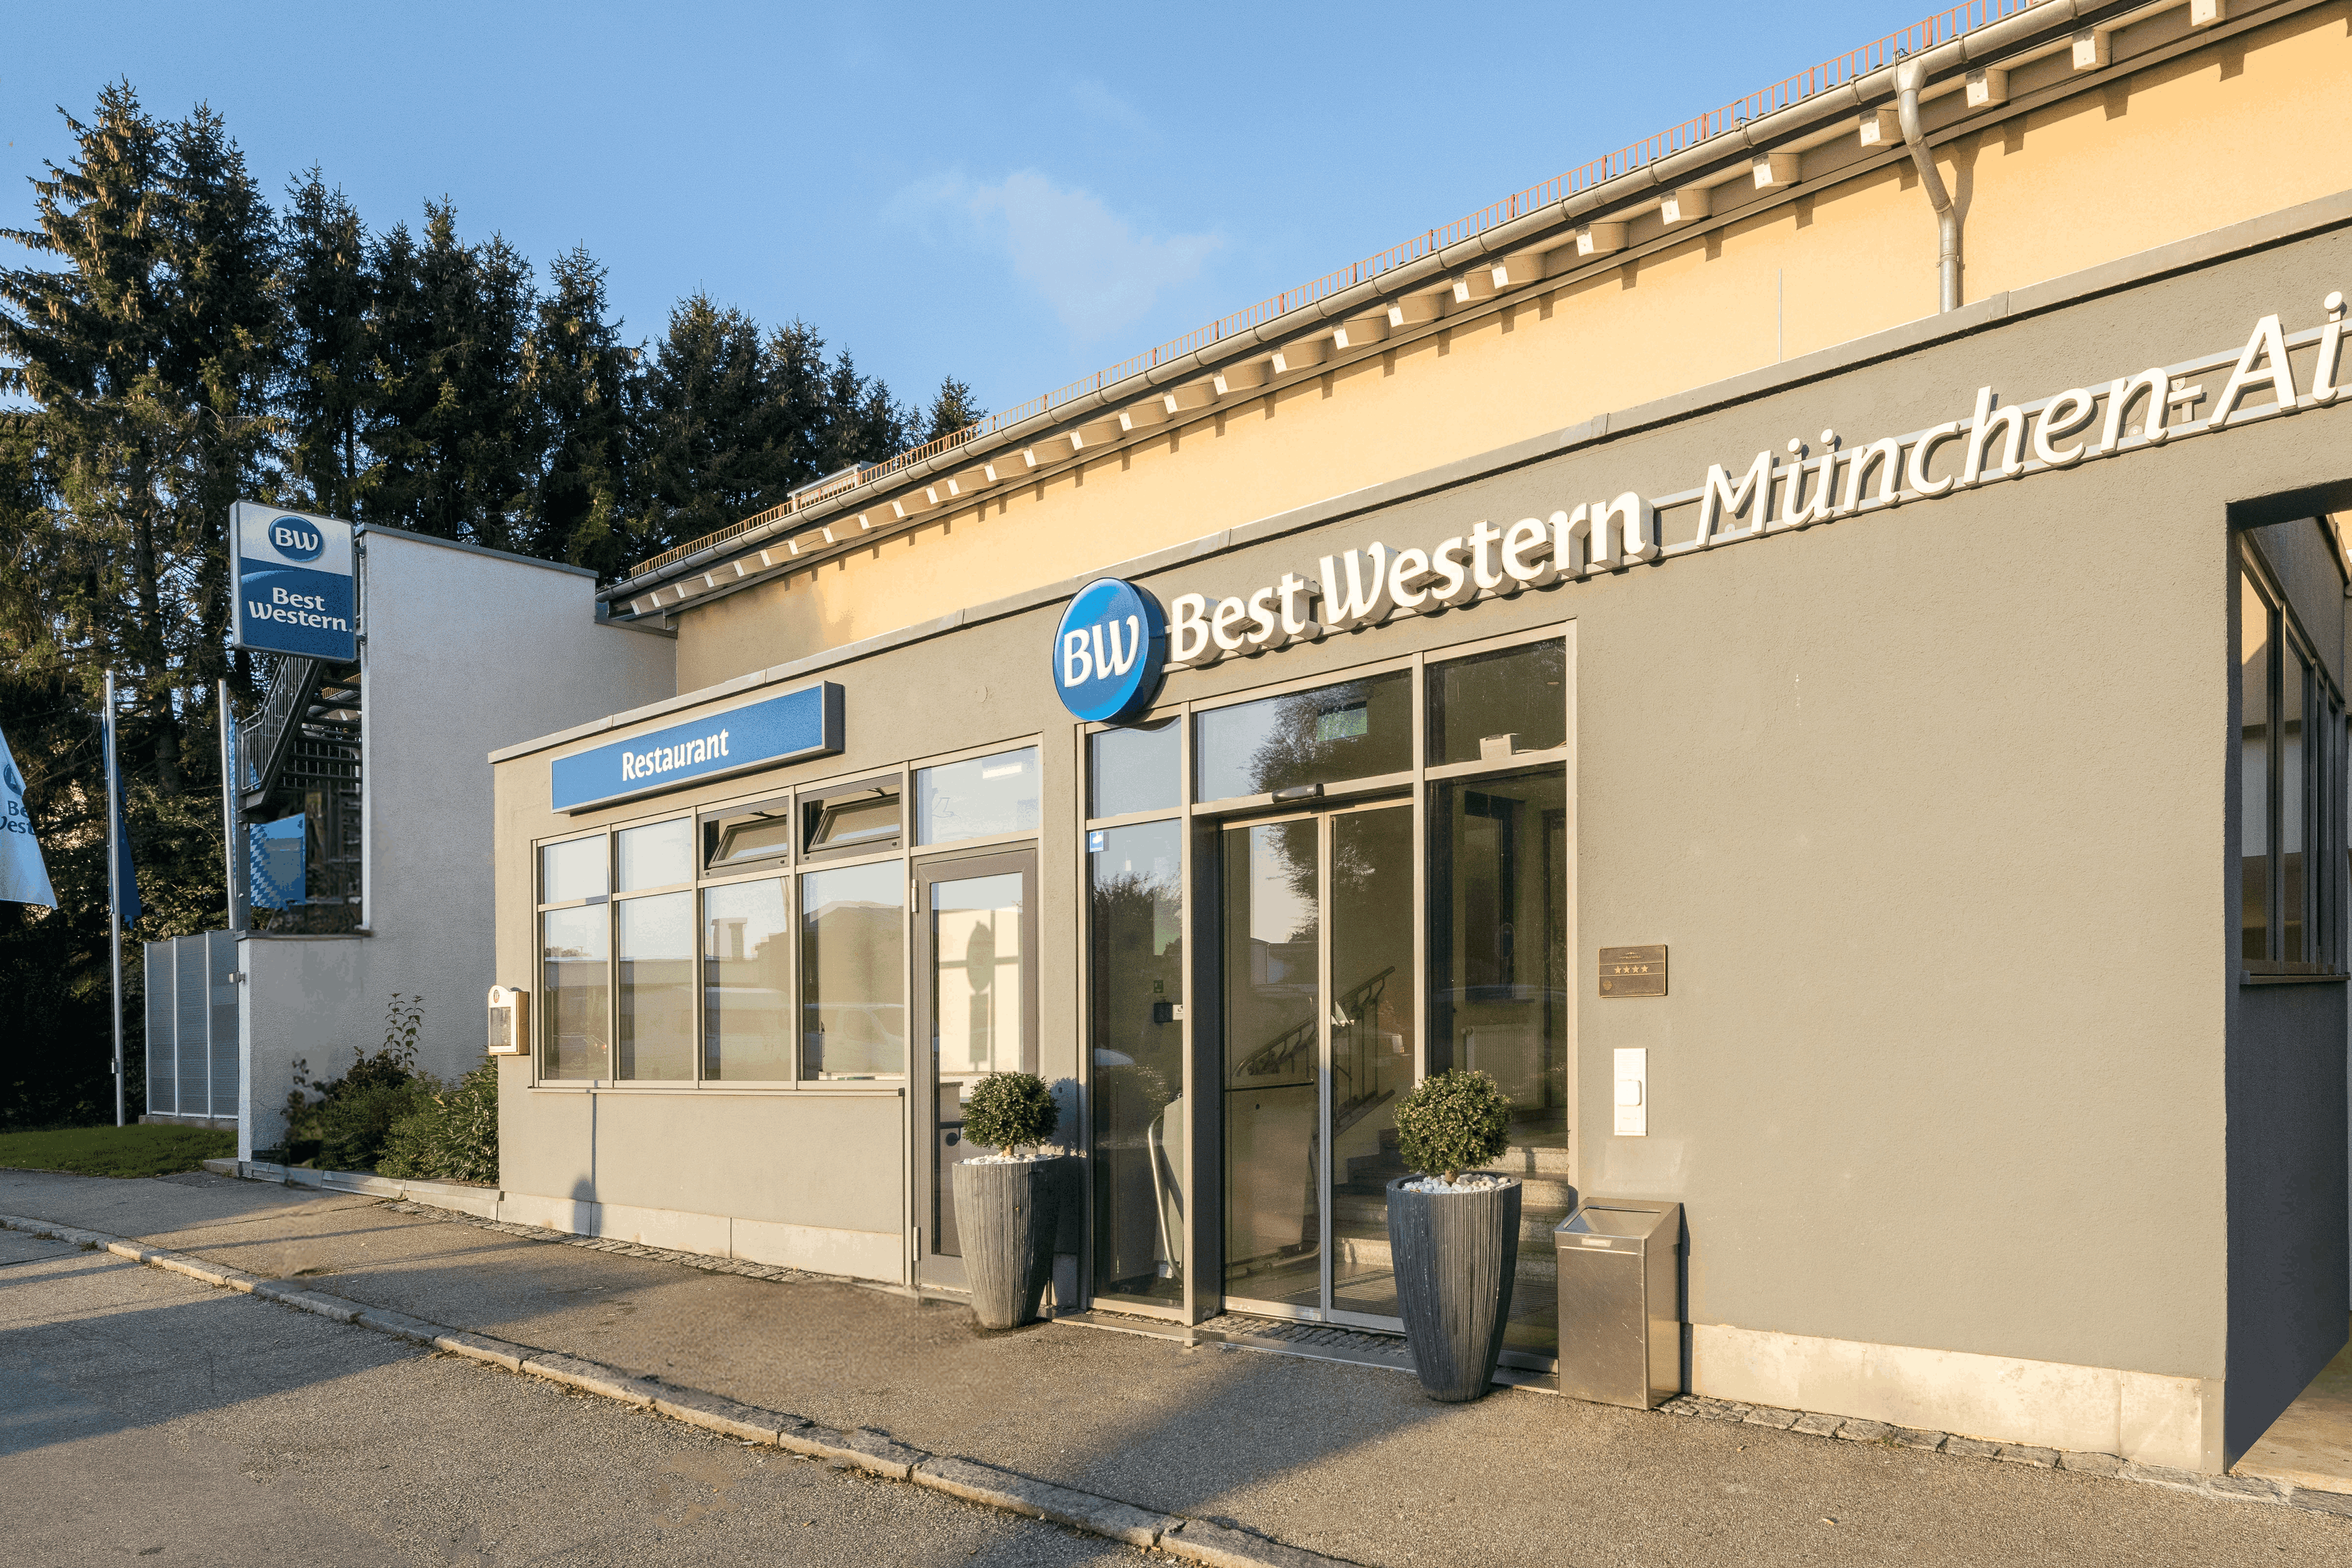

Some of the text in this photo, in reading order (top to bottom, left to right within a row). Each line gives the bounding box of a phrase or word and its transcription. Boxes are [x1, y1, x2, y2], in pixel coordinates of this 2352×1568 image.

[275, 527, 318, 551] BW
[1170, 571, 1307, 663] Best
[1319, 491, 1648, 624] Western
[248, 600, 347, 632] Western
[273, 587, 325, 611] Best
[1063, 615, 1139, 687] BW
[622, 728, 729, 781] Restaurant
